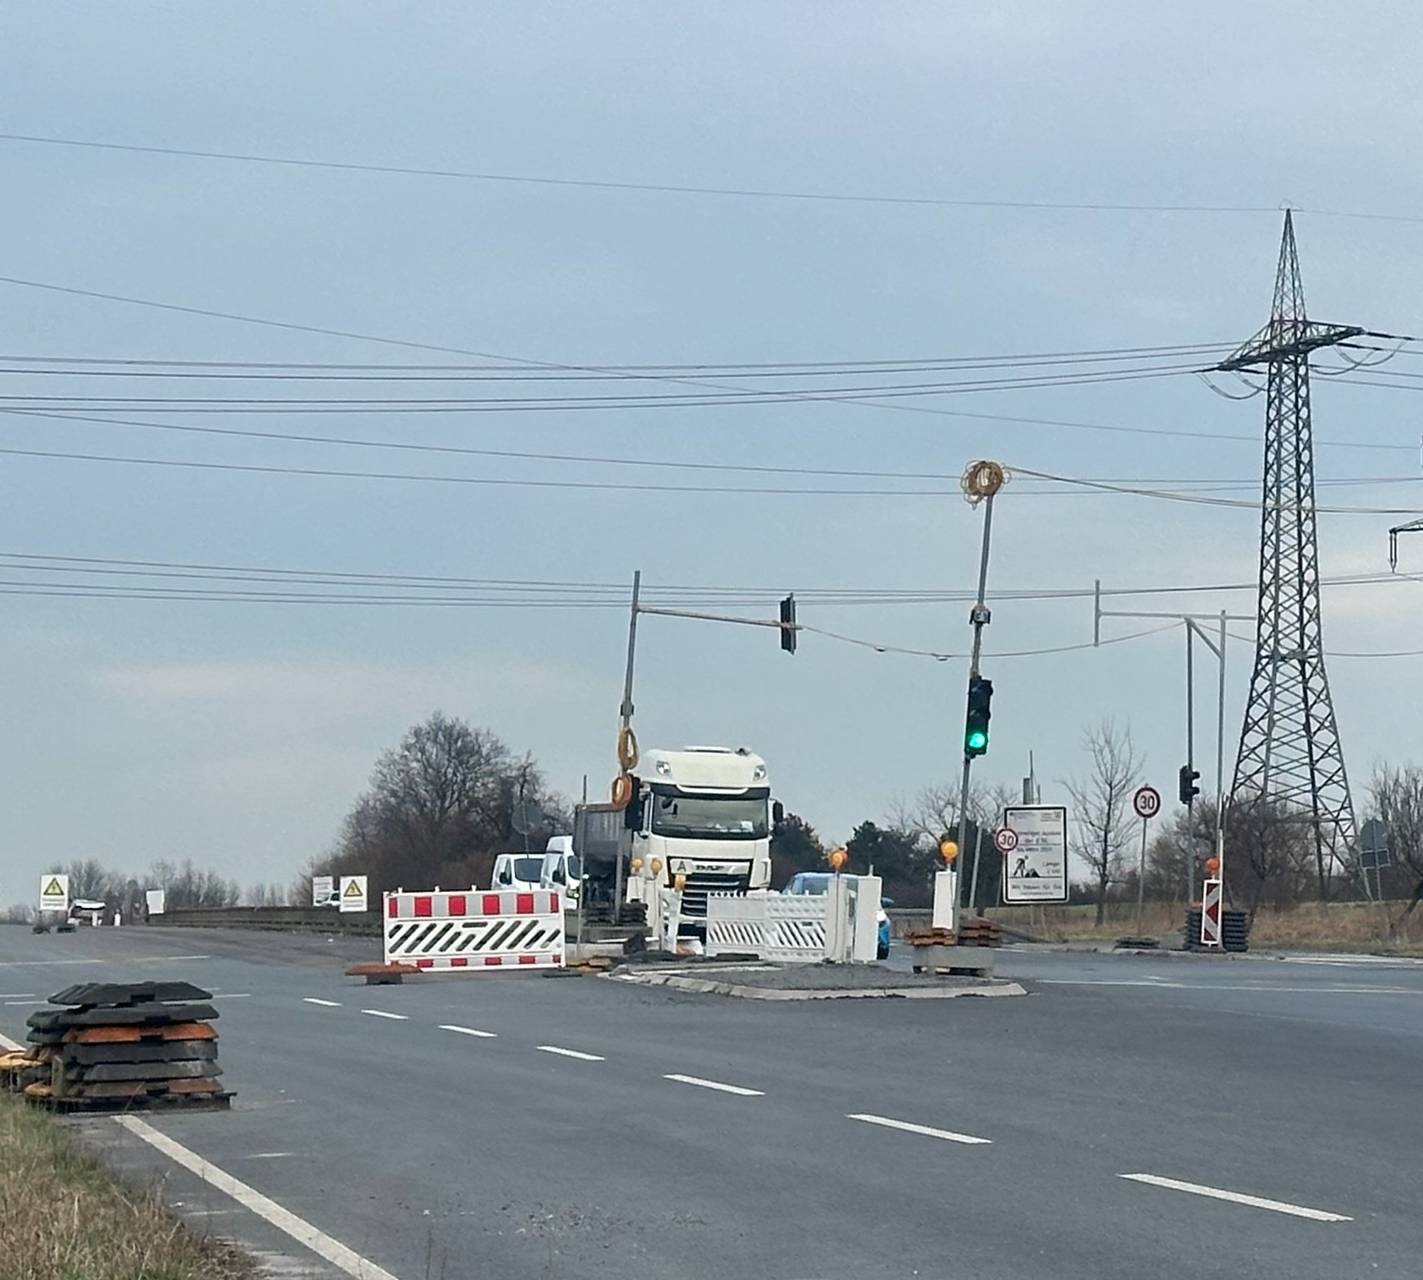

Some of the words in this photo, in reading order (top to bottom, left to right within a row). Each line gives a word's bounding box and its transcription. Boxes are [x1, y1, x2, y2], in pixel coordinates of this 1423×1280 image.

[1140, 795, 1155, 810] 30
[999, 834, 1014, 847] 30
[677, 861, 687, 872] A
